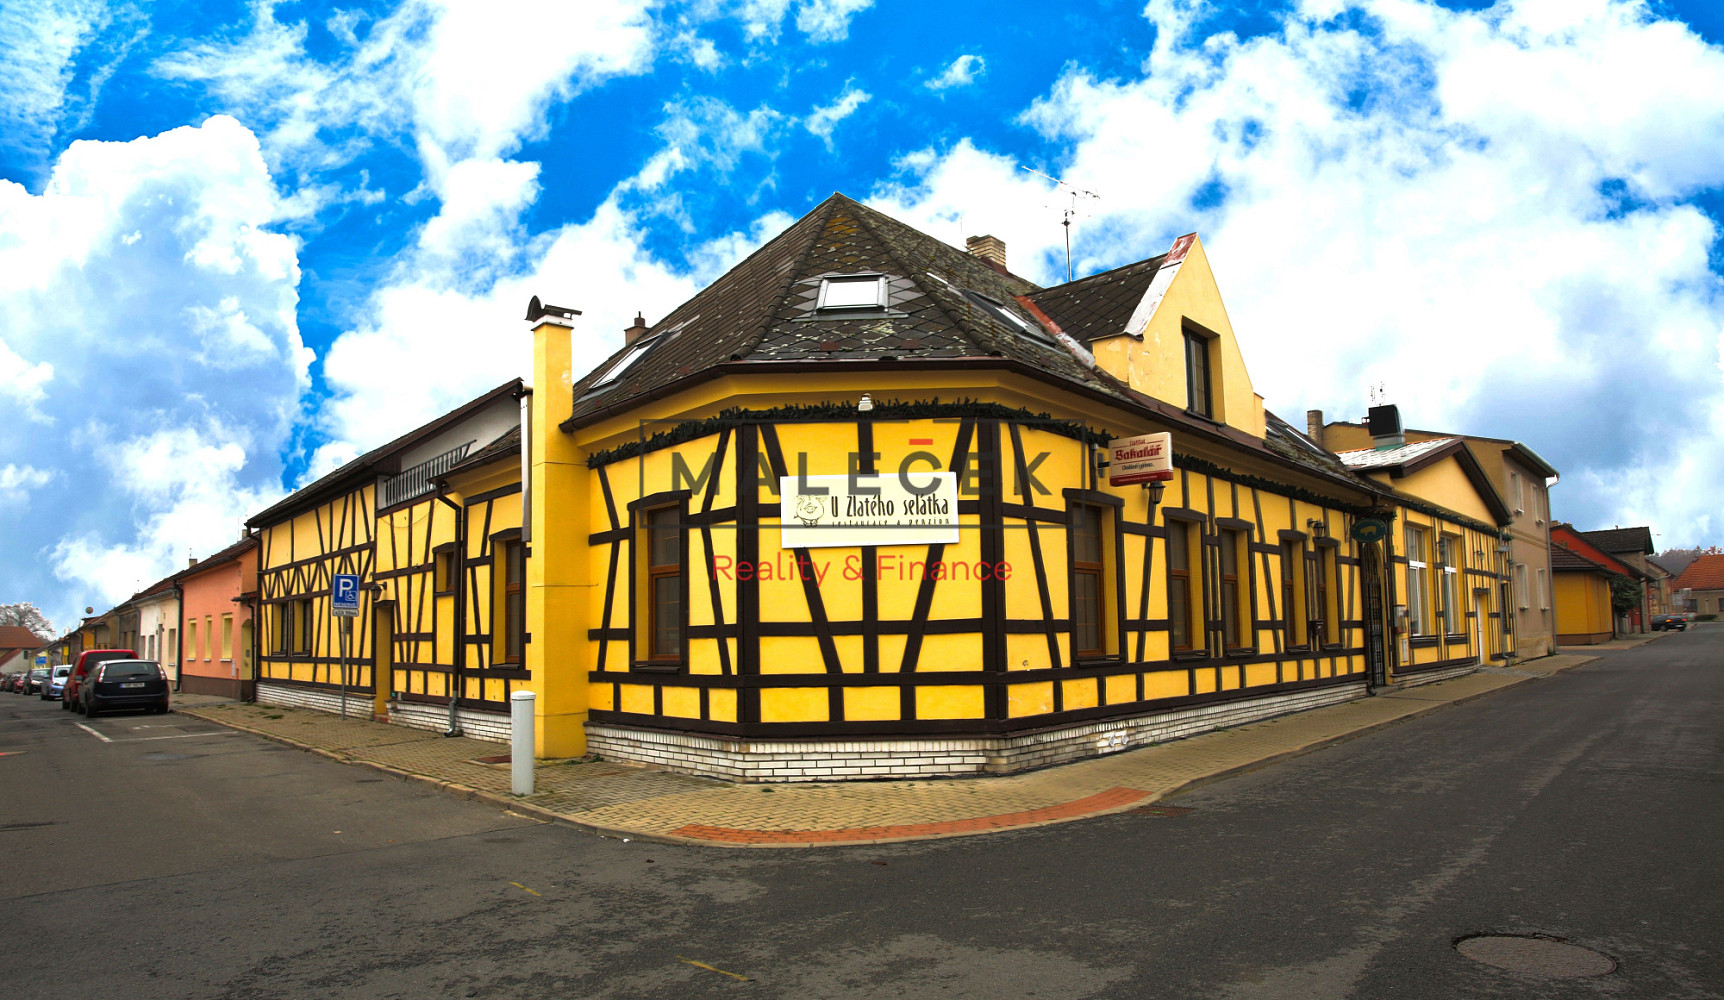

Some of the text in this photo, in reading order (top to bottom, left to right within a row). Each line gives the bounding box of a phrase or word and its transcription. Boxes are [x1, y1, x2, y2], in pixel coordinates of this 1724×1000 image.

[831, 492, 949, 517] U Zlatého selátka
[339, 578, 353, 597] P
